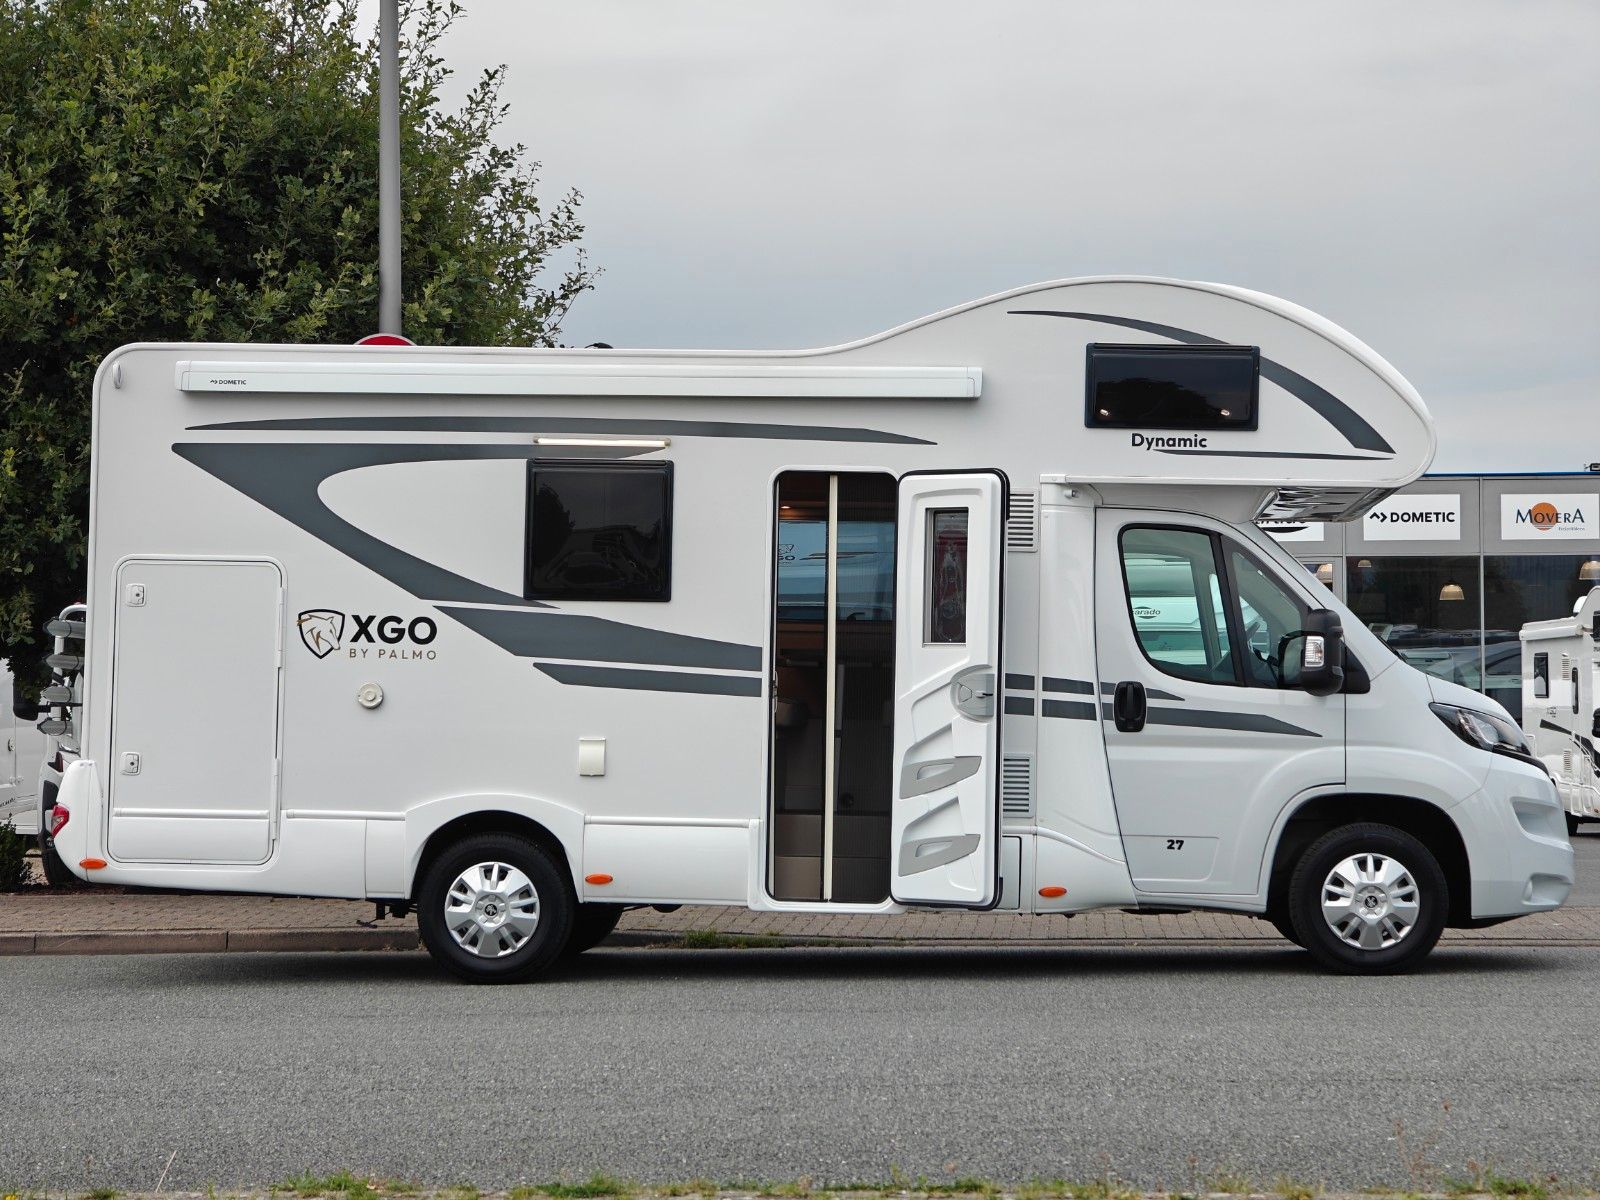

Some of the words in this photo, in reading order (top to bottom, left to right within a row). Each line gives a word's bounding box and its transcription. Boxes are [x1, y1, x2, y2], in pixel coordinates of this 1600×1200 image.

[1131, 432, 1208, 451] Dynamic
[1390, 511, 1456, 523] DOMETIC
[349, 614, 438, 645] XGO
[349, 648, 369, 659] BY
[378, 649, 437, 660] PALMO
[1166, 839, 1185, 851] 27
